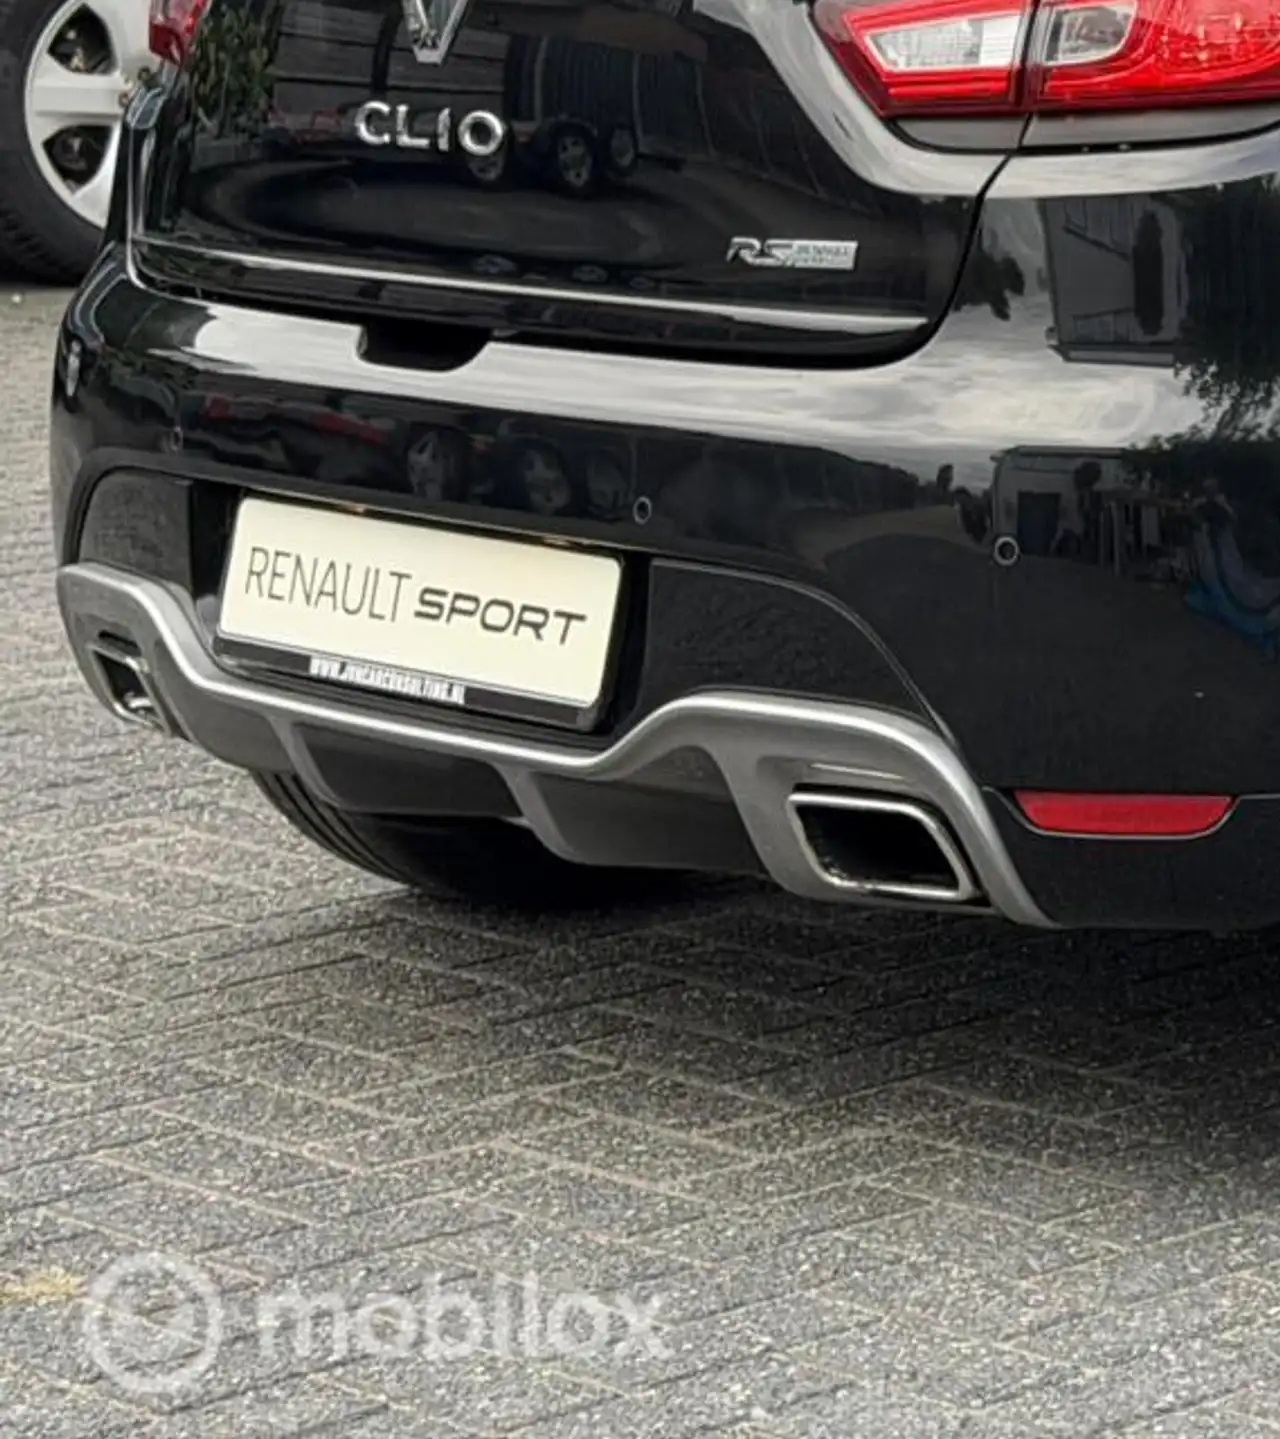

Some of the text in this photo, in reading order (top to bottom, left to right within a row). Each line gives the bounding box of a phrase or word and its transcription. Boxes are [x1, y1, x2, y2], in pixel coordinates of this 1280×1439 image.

[354, 100, 506, 157] CLIO
[245, 546, 587, 646] RENAULT SPORT
